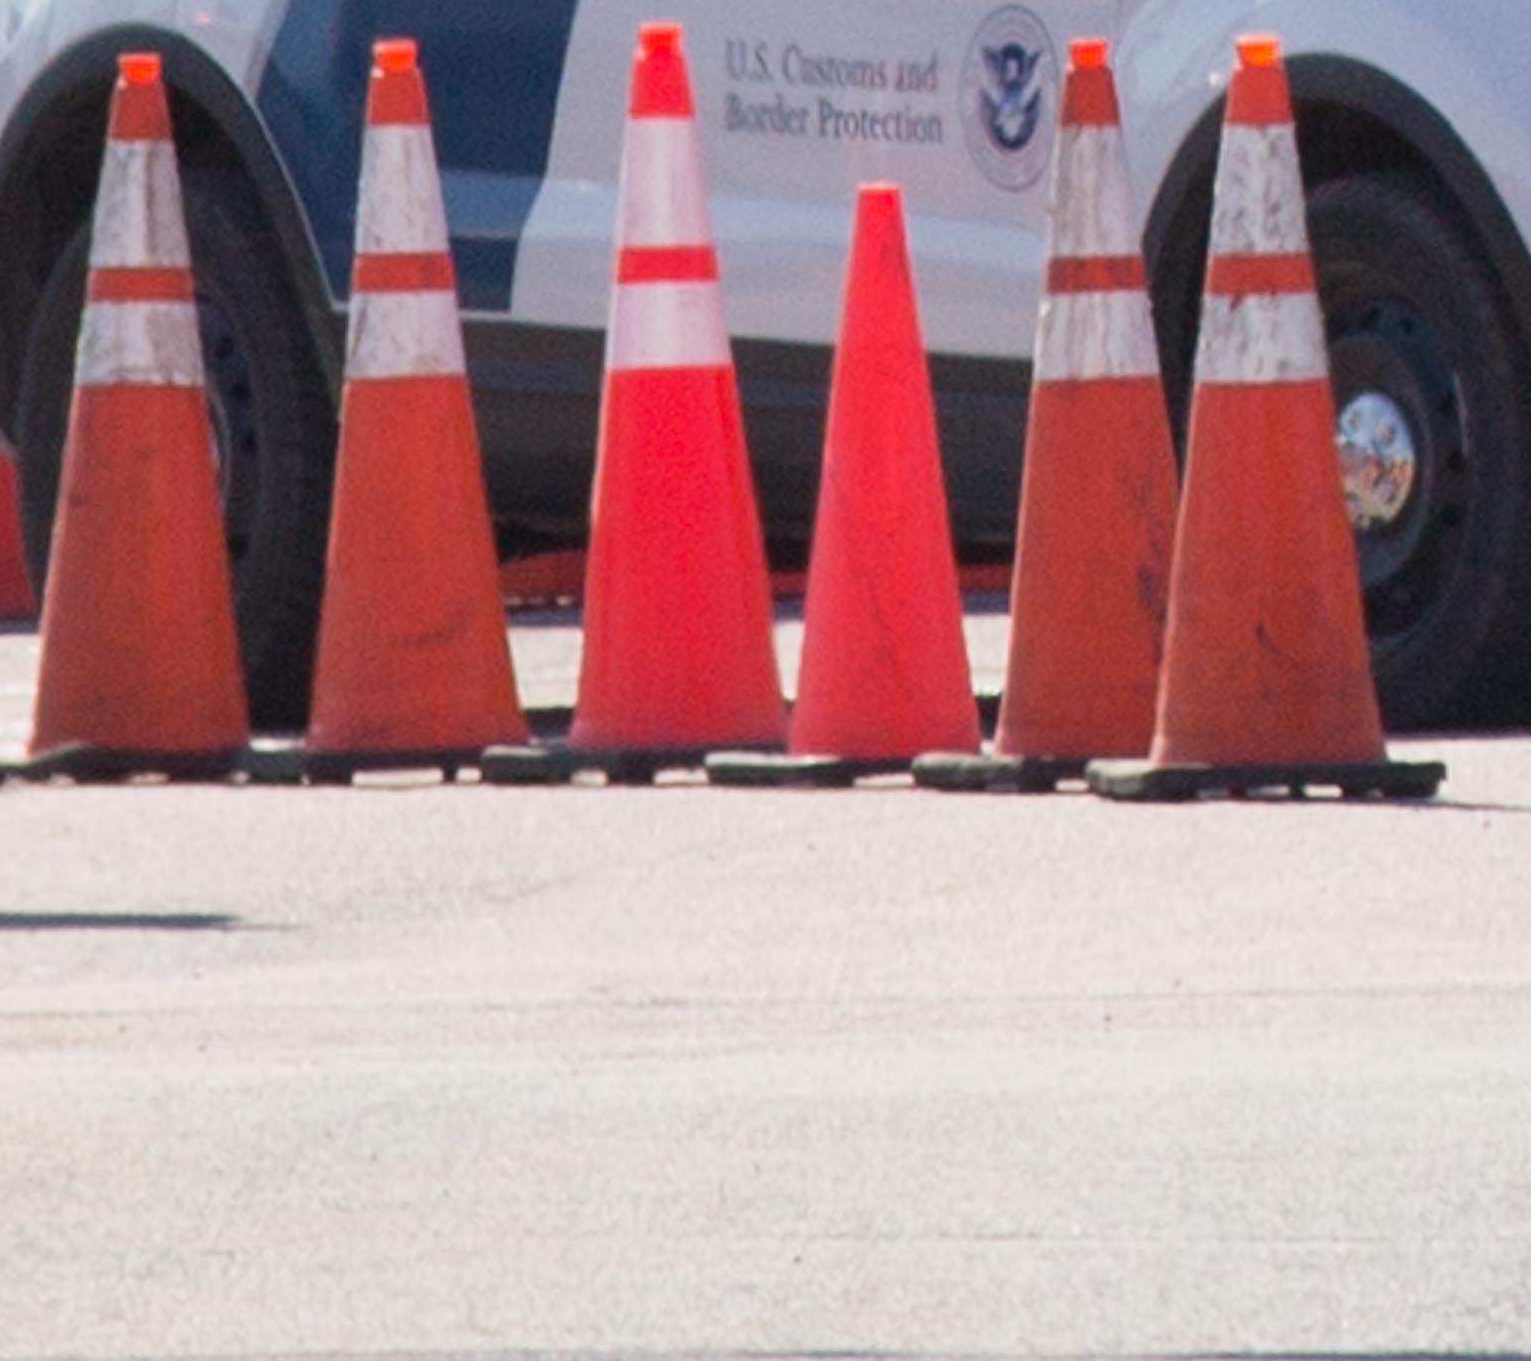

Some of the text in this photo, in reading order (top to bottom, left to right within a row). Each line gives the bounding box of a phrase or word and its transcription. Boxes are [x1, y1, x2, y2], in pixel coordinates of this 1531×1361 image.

[782, 42, 887, 93] Customs
[894, 47, 939, 93] and
[725, 91, 944, 145] Border Protection
